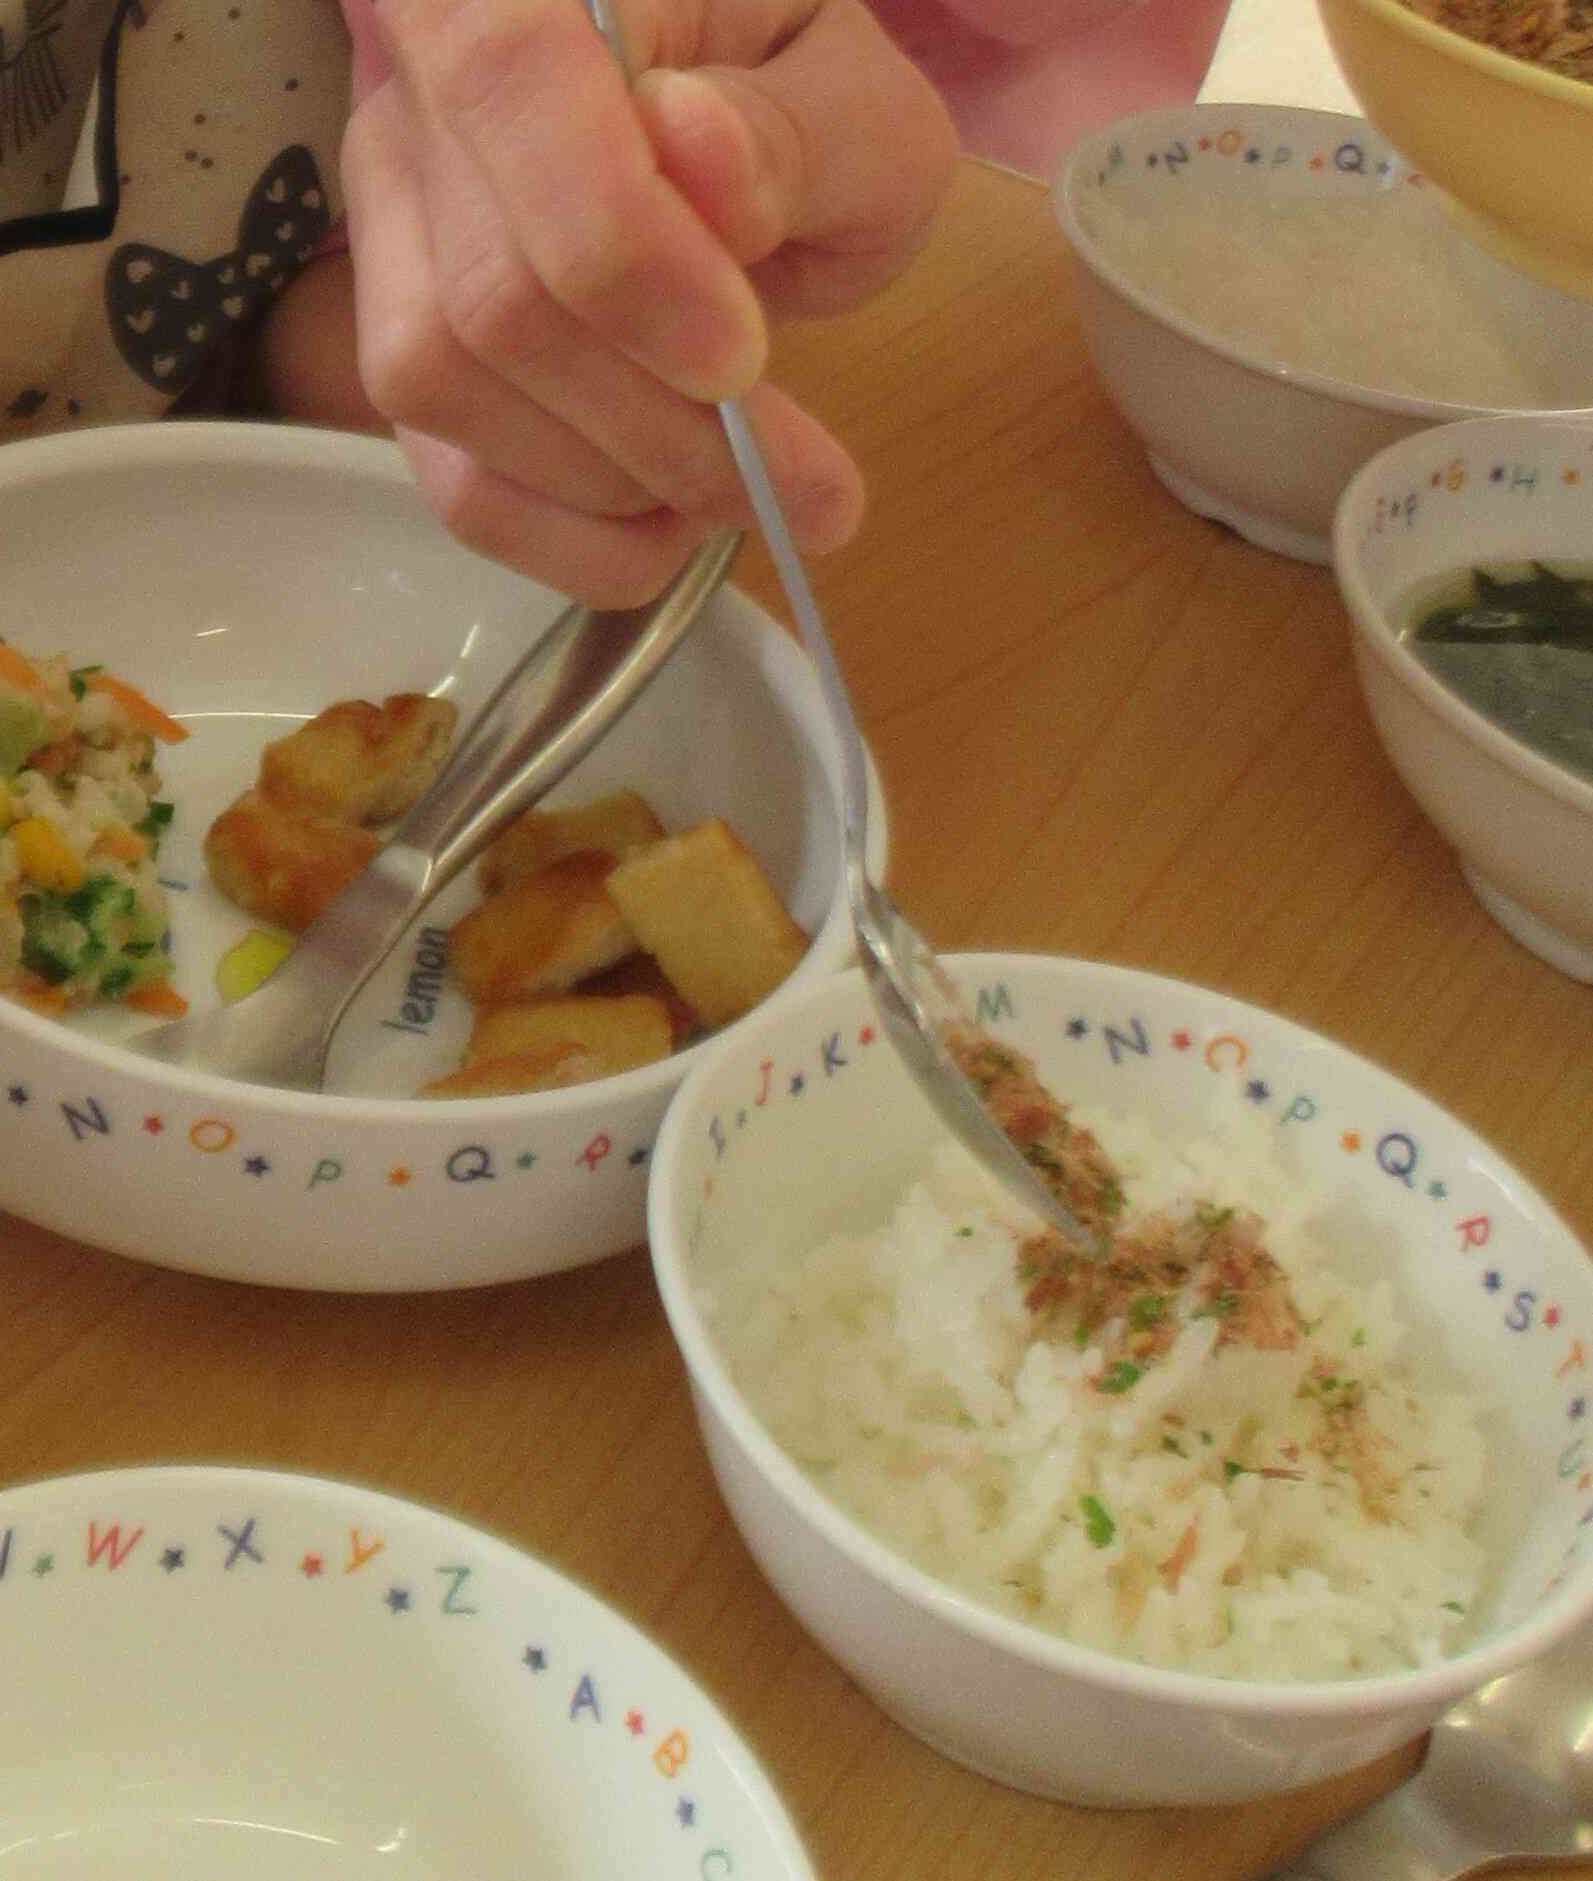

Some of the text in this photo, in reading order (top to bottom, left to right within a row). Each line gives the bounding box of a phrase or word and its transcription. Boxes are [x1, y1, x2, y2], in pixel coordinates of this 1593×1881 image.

[1216, 128, 1244, 158] O
[1334, 142, 1366, 175] Q
[380, 926, 449, 1036] lemon
[61, 1096, 110, 1141] N
[188, 1119, 236, 1153] O
[308, 1157, 343, 1191] P
[445, 1145, 495, 1183] Q
[573, 1133, 612, 1172] R
[755, 1059, 775, 1107] J
[821, 1031, 849, 1078] K
[976, 982, 1014, 1020] M
[1105, 1017, 1151, 1064] N
[1280, 1095, 1316, 1126] P
[1376, 1132, 1417, 1189] Q
[1455, 1215, 1492, 1252] R
[1505, 1290, 1537, 1332] S
[88, 1520, 145, 1572] W
[219, 1518, 263, 1571] X
[344, 1526, 386, 1575] Y
[435, 1564, 477, 1615] Z
[569, 1673, 602, 1723] A
[652, 1727, 690, 1779] B
